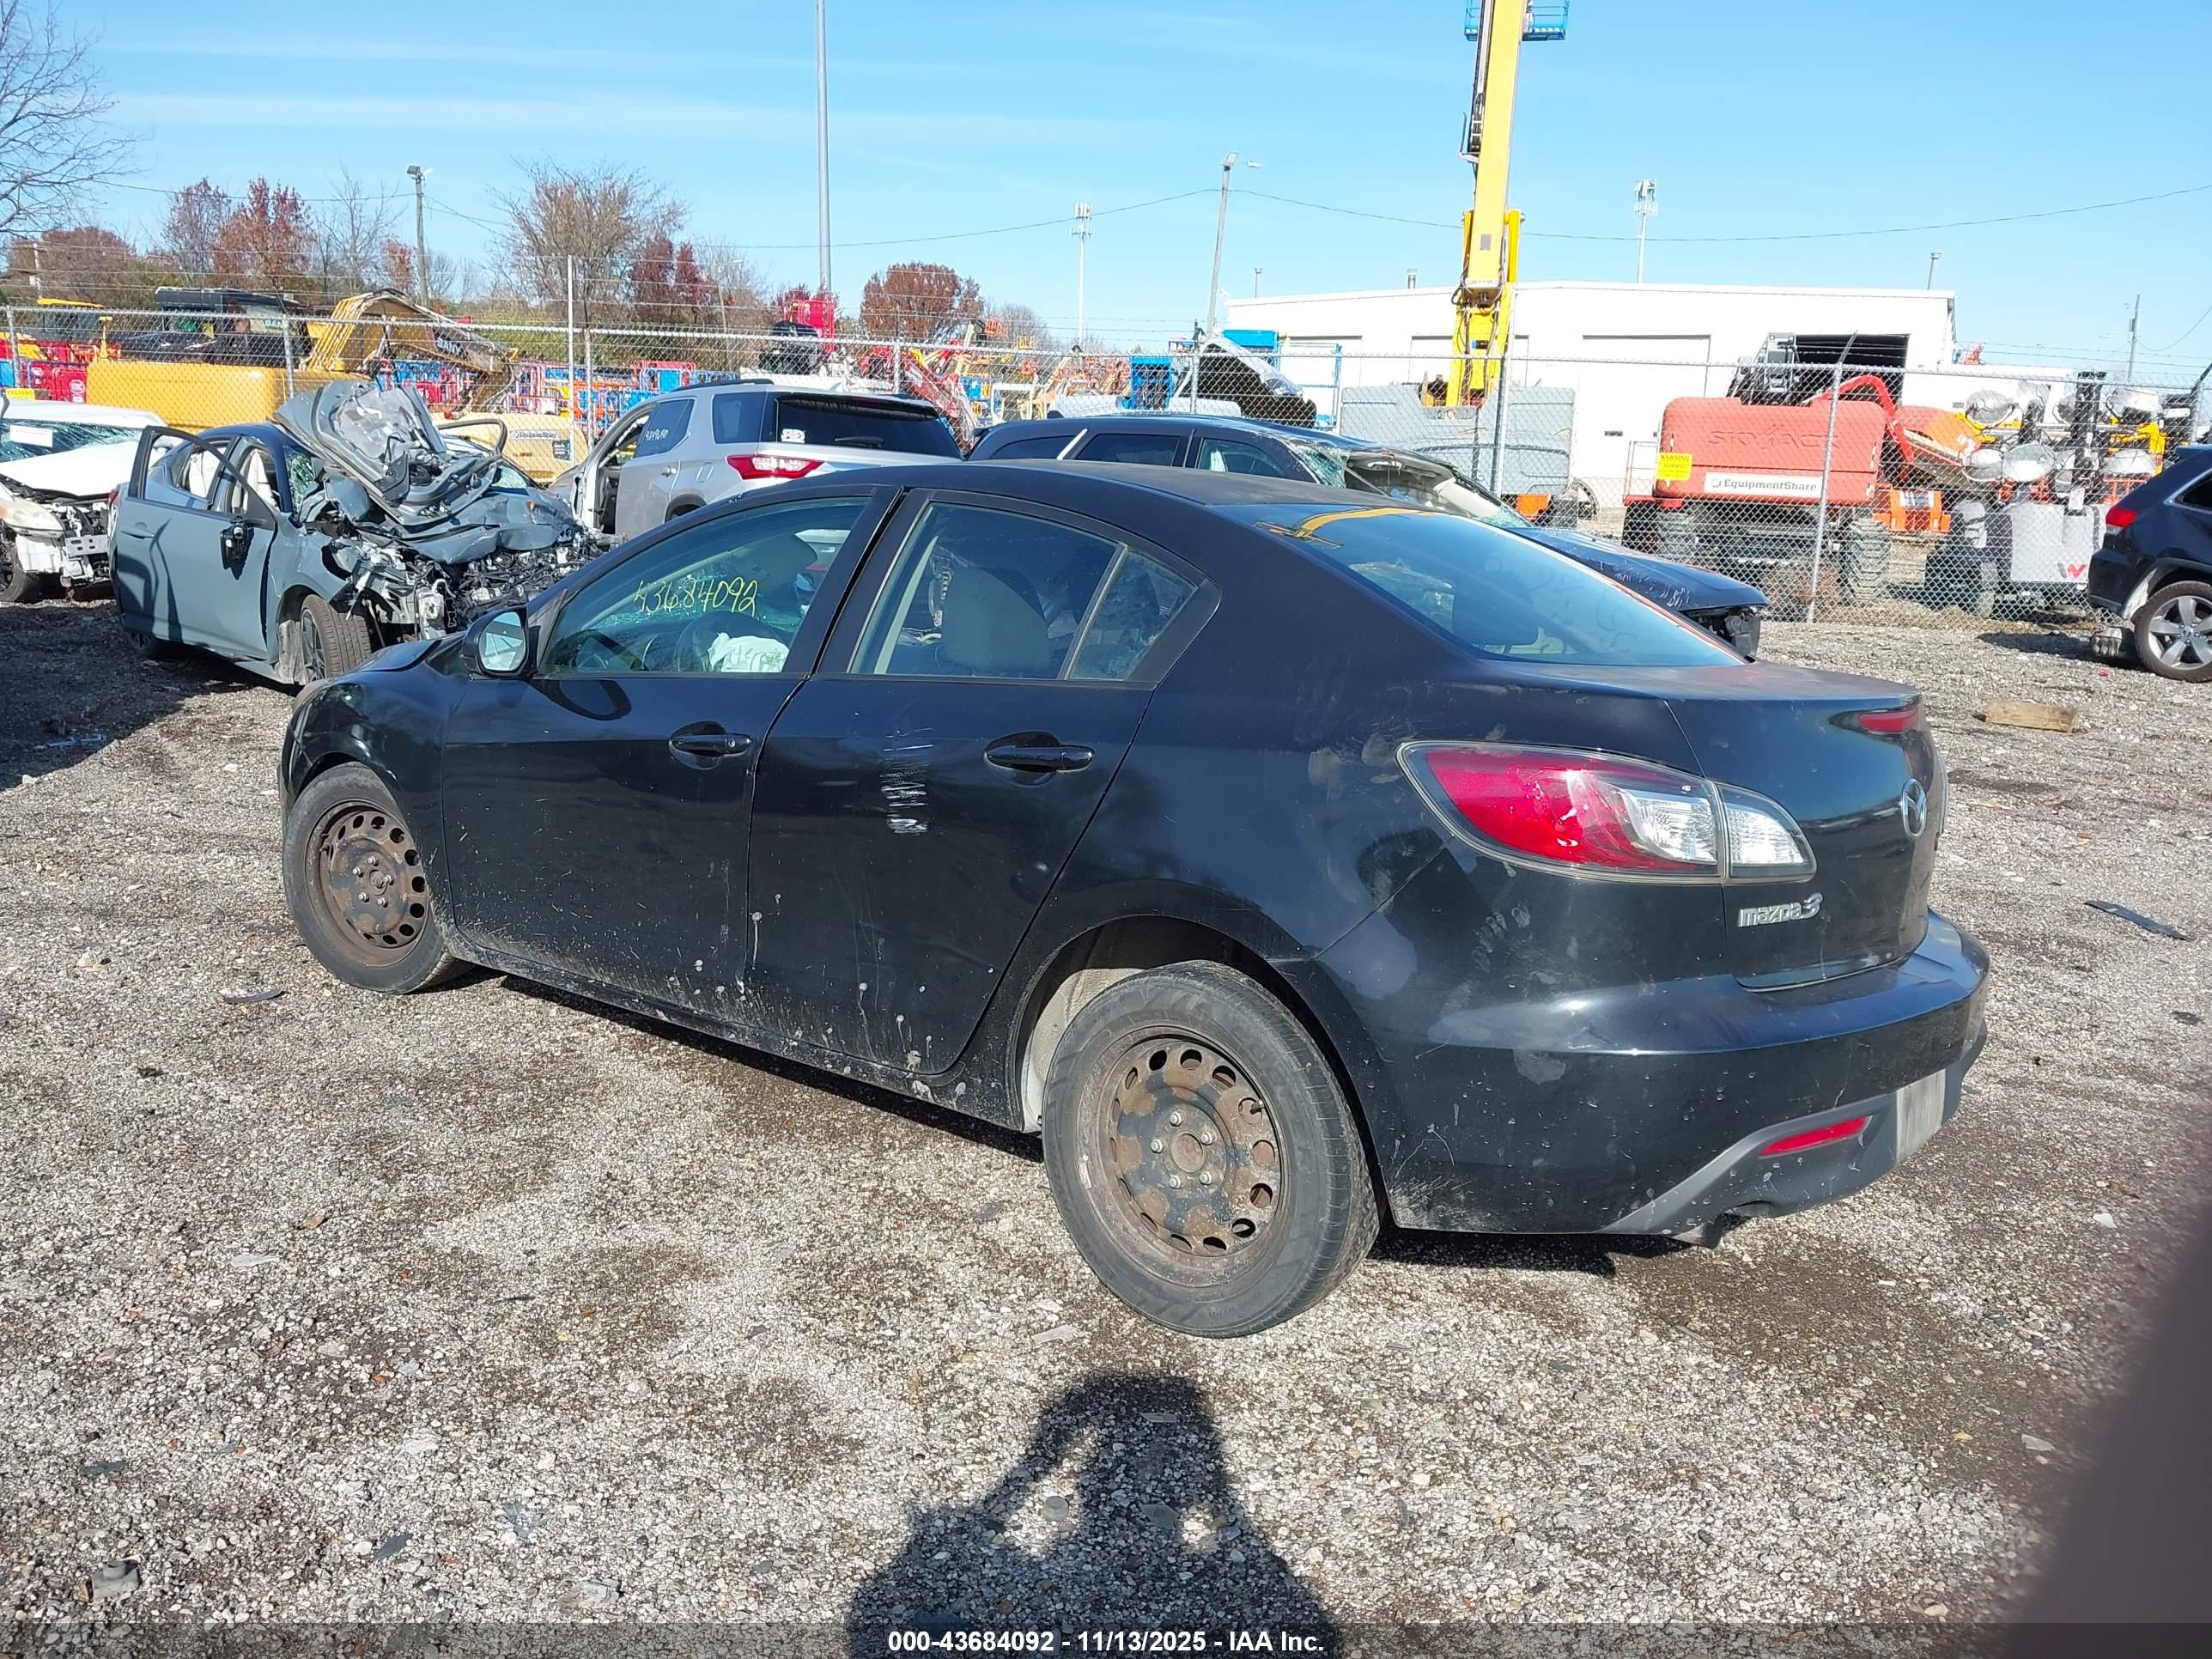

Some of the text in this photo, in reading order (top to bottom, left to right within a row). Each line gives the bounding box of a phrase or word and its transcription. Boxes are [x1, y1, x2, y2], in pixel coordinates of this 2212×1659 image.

[1661, 453, 1690, 462] WARNING
[1723, 479, 1817, 491] EquipmentShare
[634, 577, 758, 617] 43684092
